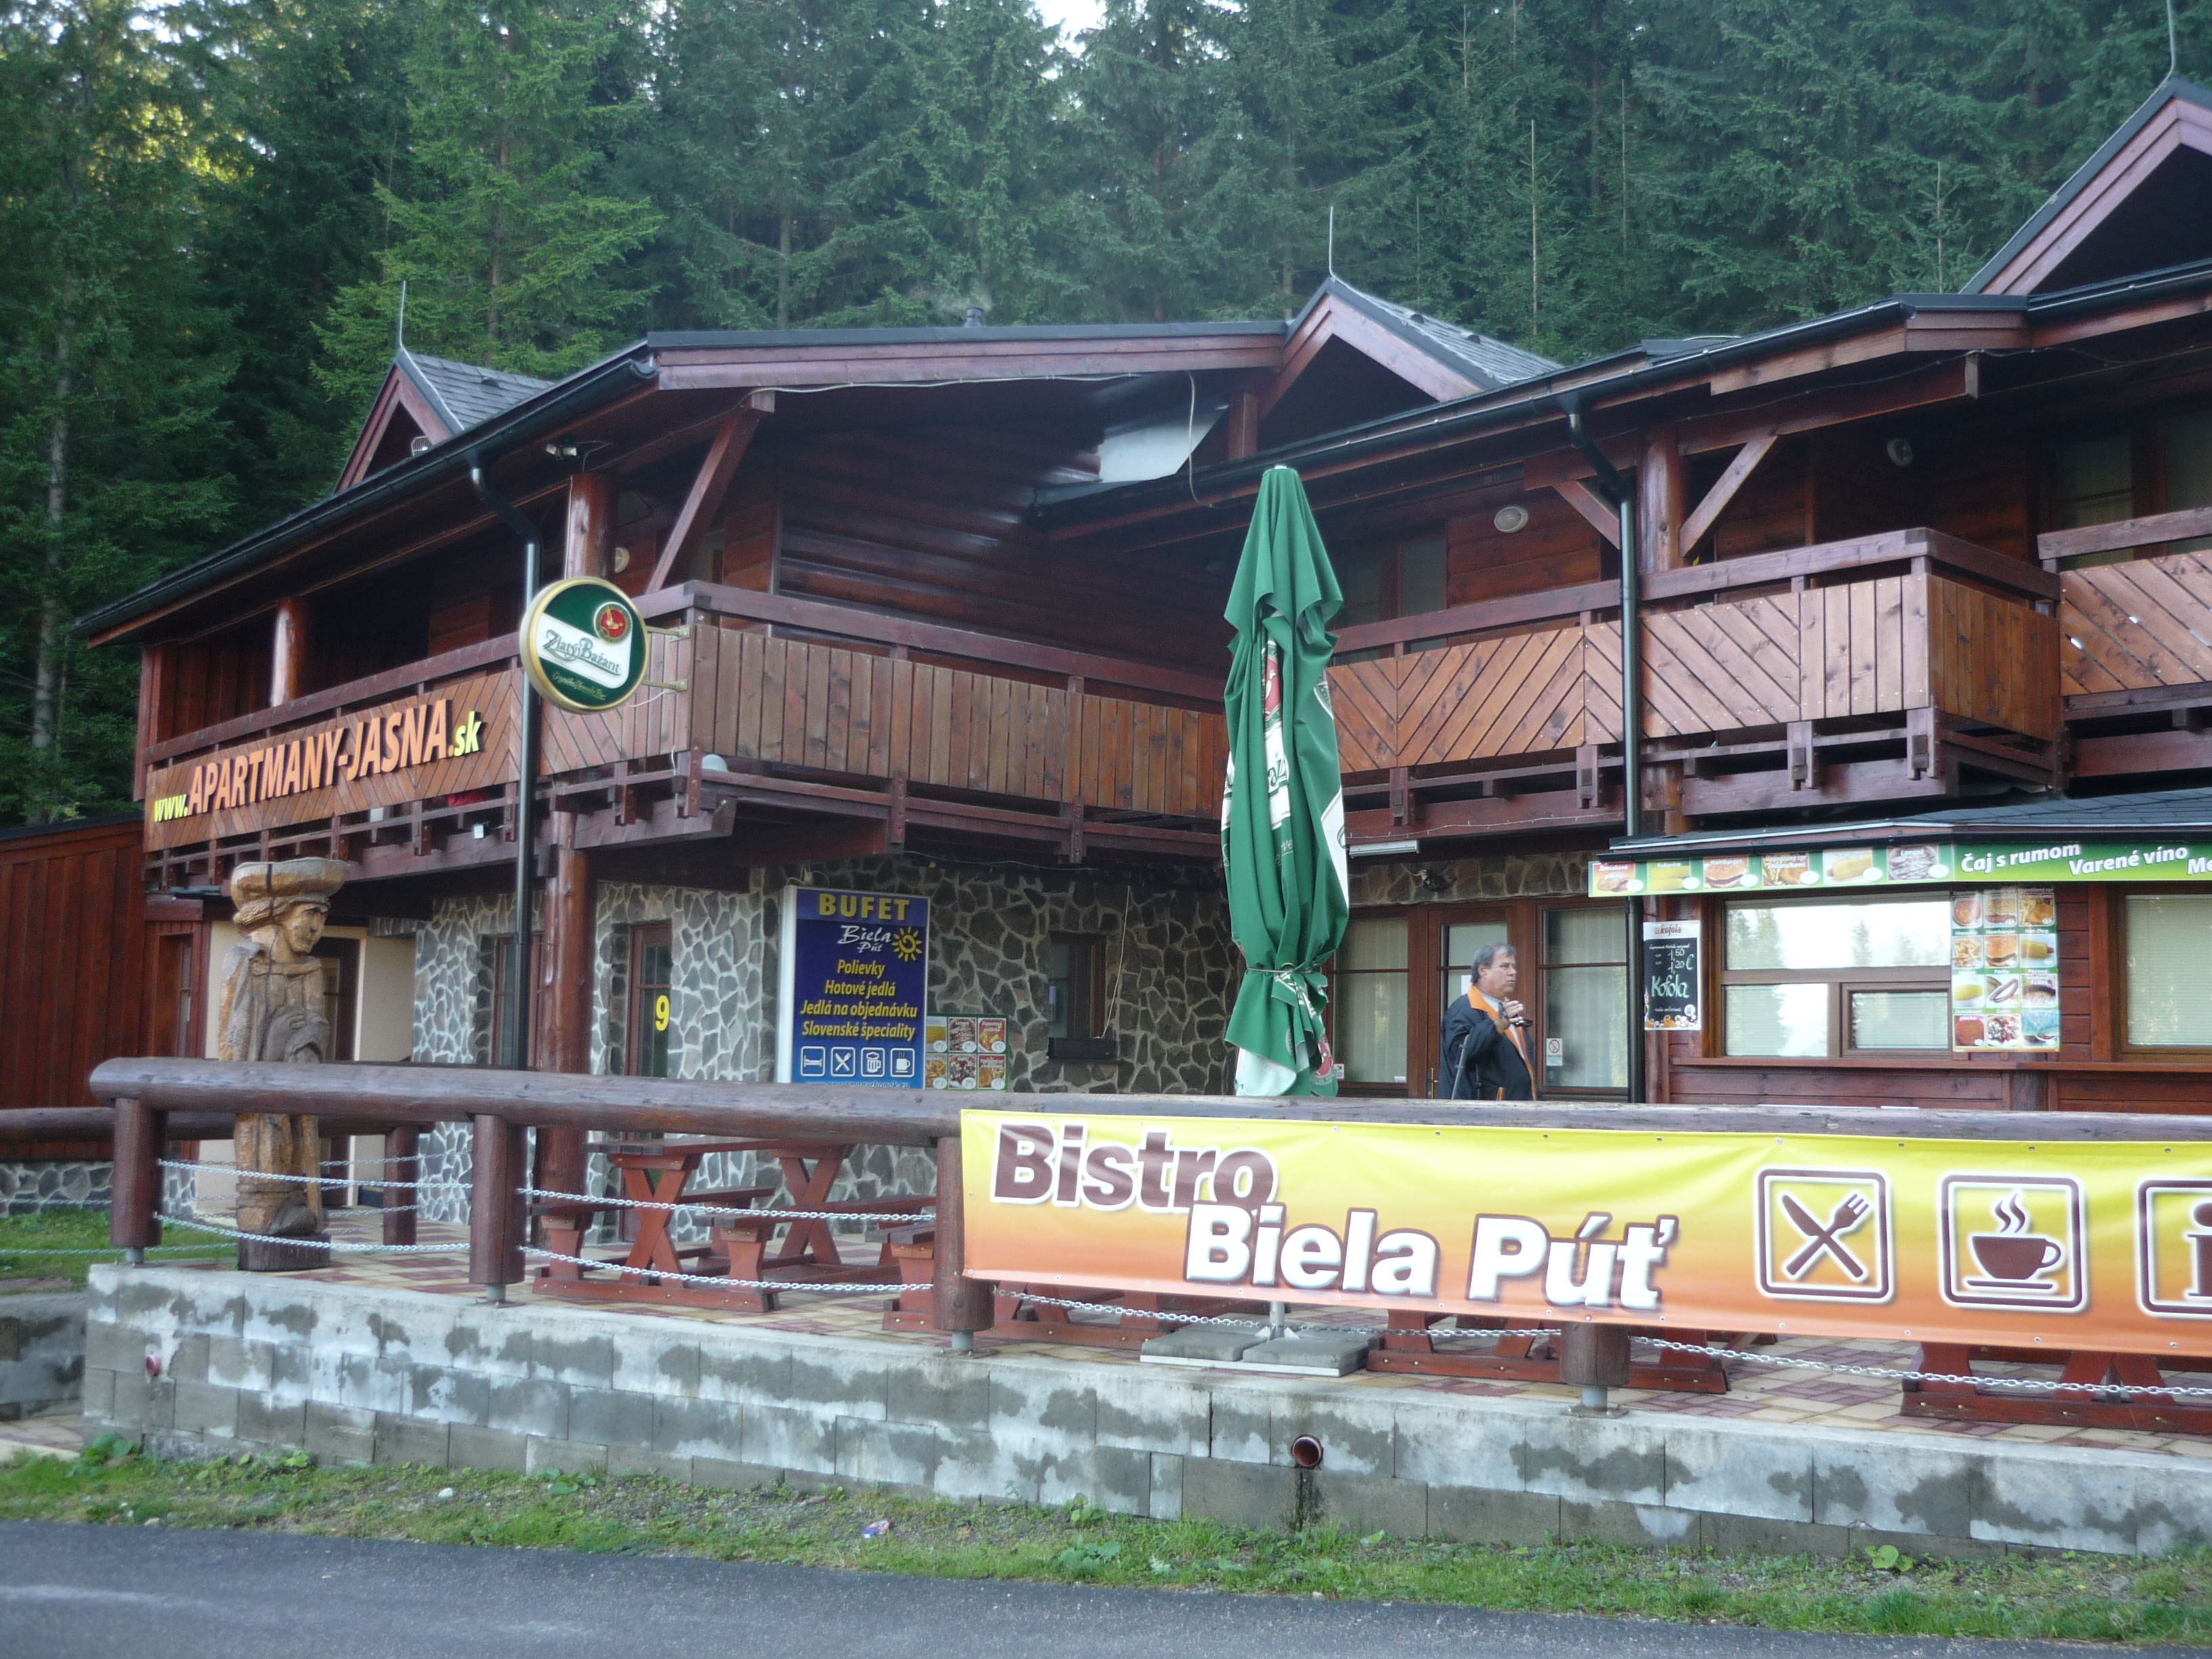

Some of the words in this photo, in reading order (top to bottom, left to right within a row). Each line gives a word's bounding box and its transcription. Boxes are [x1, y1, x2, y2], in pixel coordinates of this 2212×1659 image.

[579, 637, 621, 676] Bažant
[154, 699, 483, 822] www.APARTMANY-JASNA.sk
[1961, 853, 1991, 874] Čaj
[1996, 855, 2005, 867] s
[2009, 844, 2081, 865] rumom
[2069, 850, 2139, 876] Varené
[2143, 846, 2188, 864] víno
[819, 893, 909, 920] BUFET
[838, 925, 892, 945] Biela
[837, 959, 885, 979] Polievky
[825, 980, 865, 995] Hotové
[866, 982, 896, 999] jedlá
[1651, 974, 1690, 998] Kofola
[655, 995, 670, 1031] 9
[800, 1000, 832, 1015] Jedlá
[834, 1004, 848, 1015] na
[850, 1002, 918, 1019] objednávku
[802, 1021, 859, 1037] Slovenské
[861, 1023, 916, 1042] špeciality
[993, 1122, 1275, 1212] Bistro
[1183, 1201, 1439, 1296] Biela
[1467, 1212, 1679, 1311] Púť
